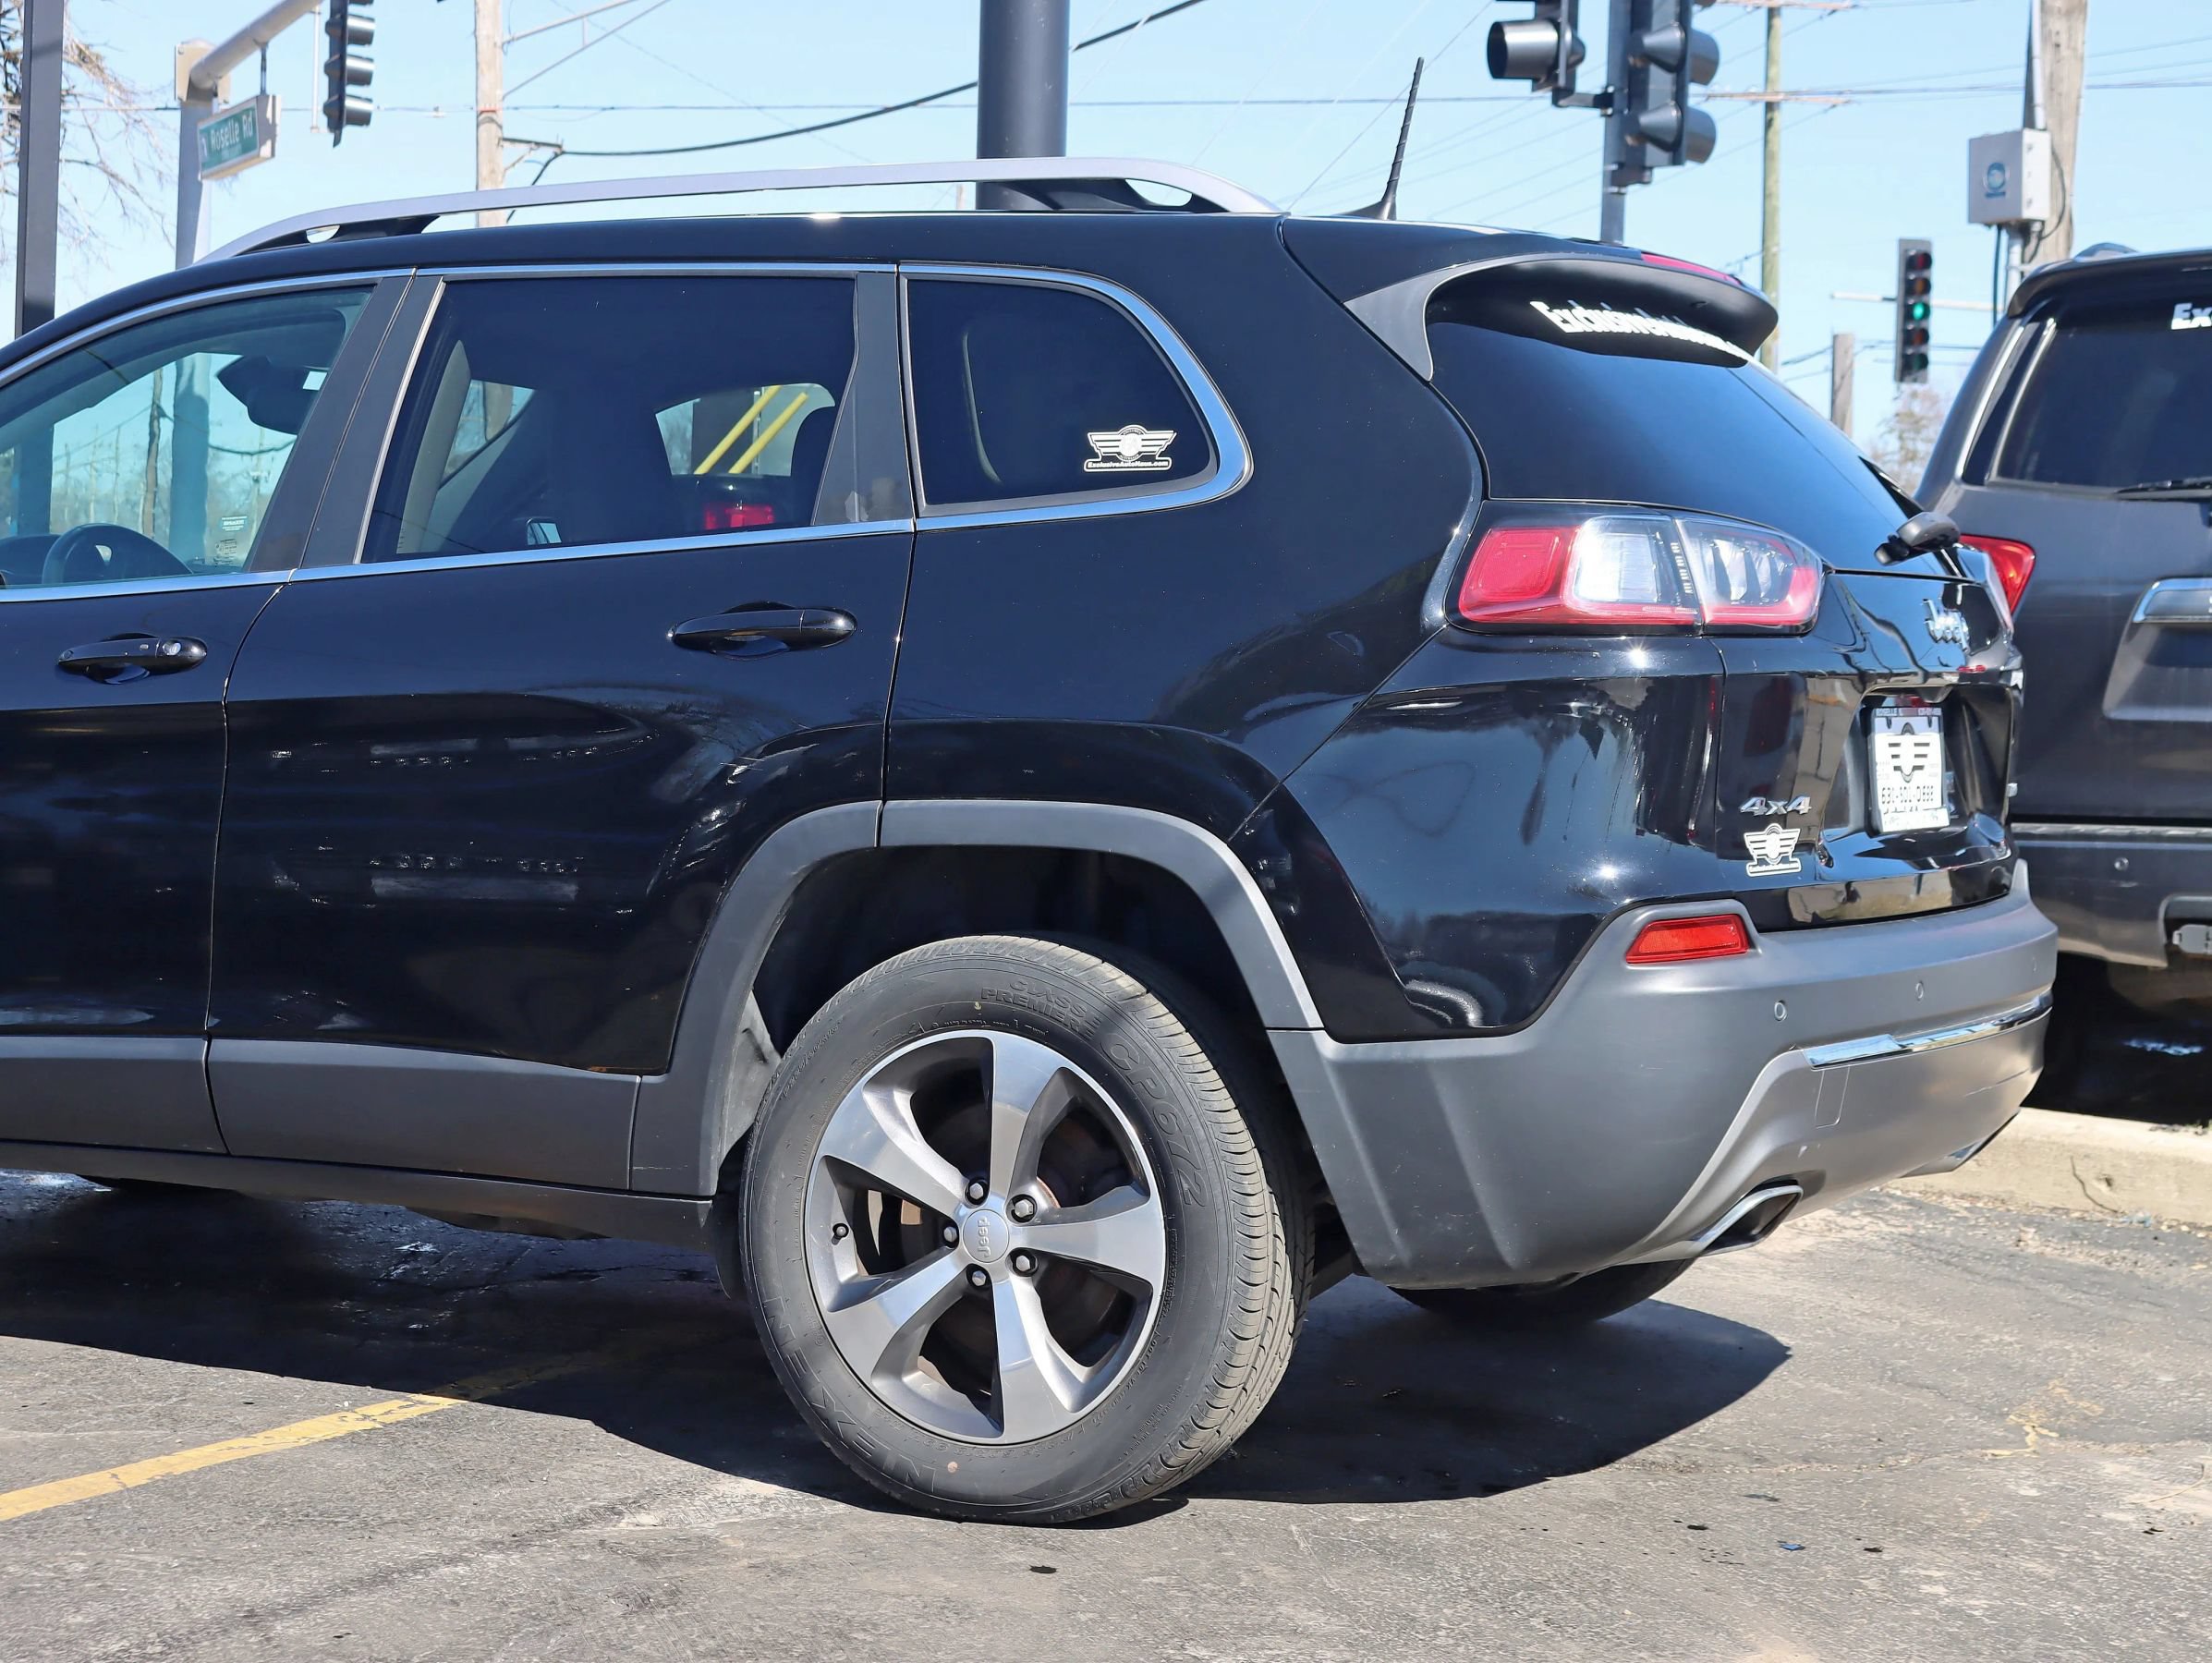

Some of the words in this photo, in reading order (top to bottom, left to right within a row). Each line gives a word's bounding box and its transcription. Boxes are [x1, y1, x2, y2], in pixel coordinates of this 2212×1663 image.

[211, 118, 240, 151] Roselle
[242, 110, 254, 139] Rd
[1923, 599, 1971, 652] Jeep
[1739, 796, 1812, 816] 4x4
[981, 988, 1096, 1042] PREMIERE
[1100, 1031, 1205, 1208] CP672
[978, 1216, 991, 1257] Jeep
[762, 1297, 937, 1493] NEXEN
